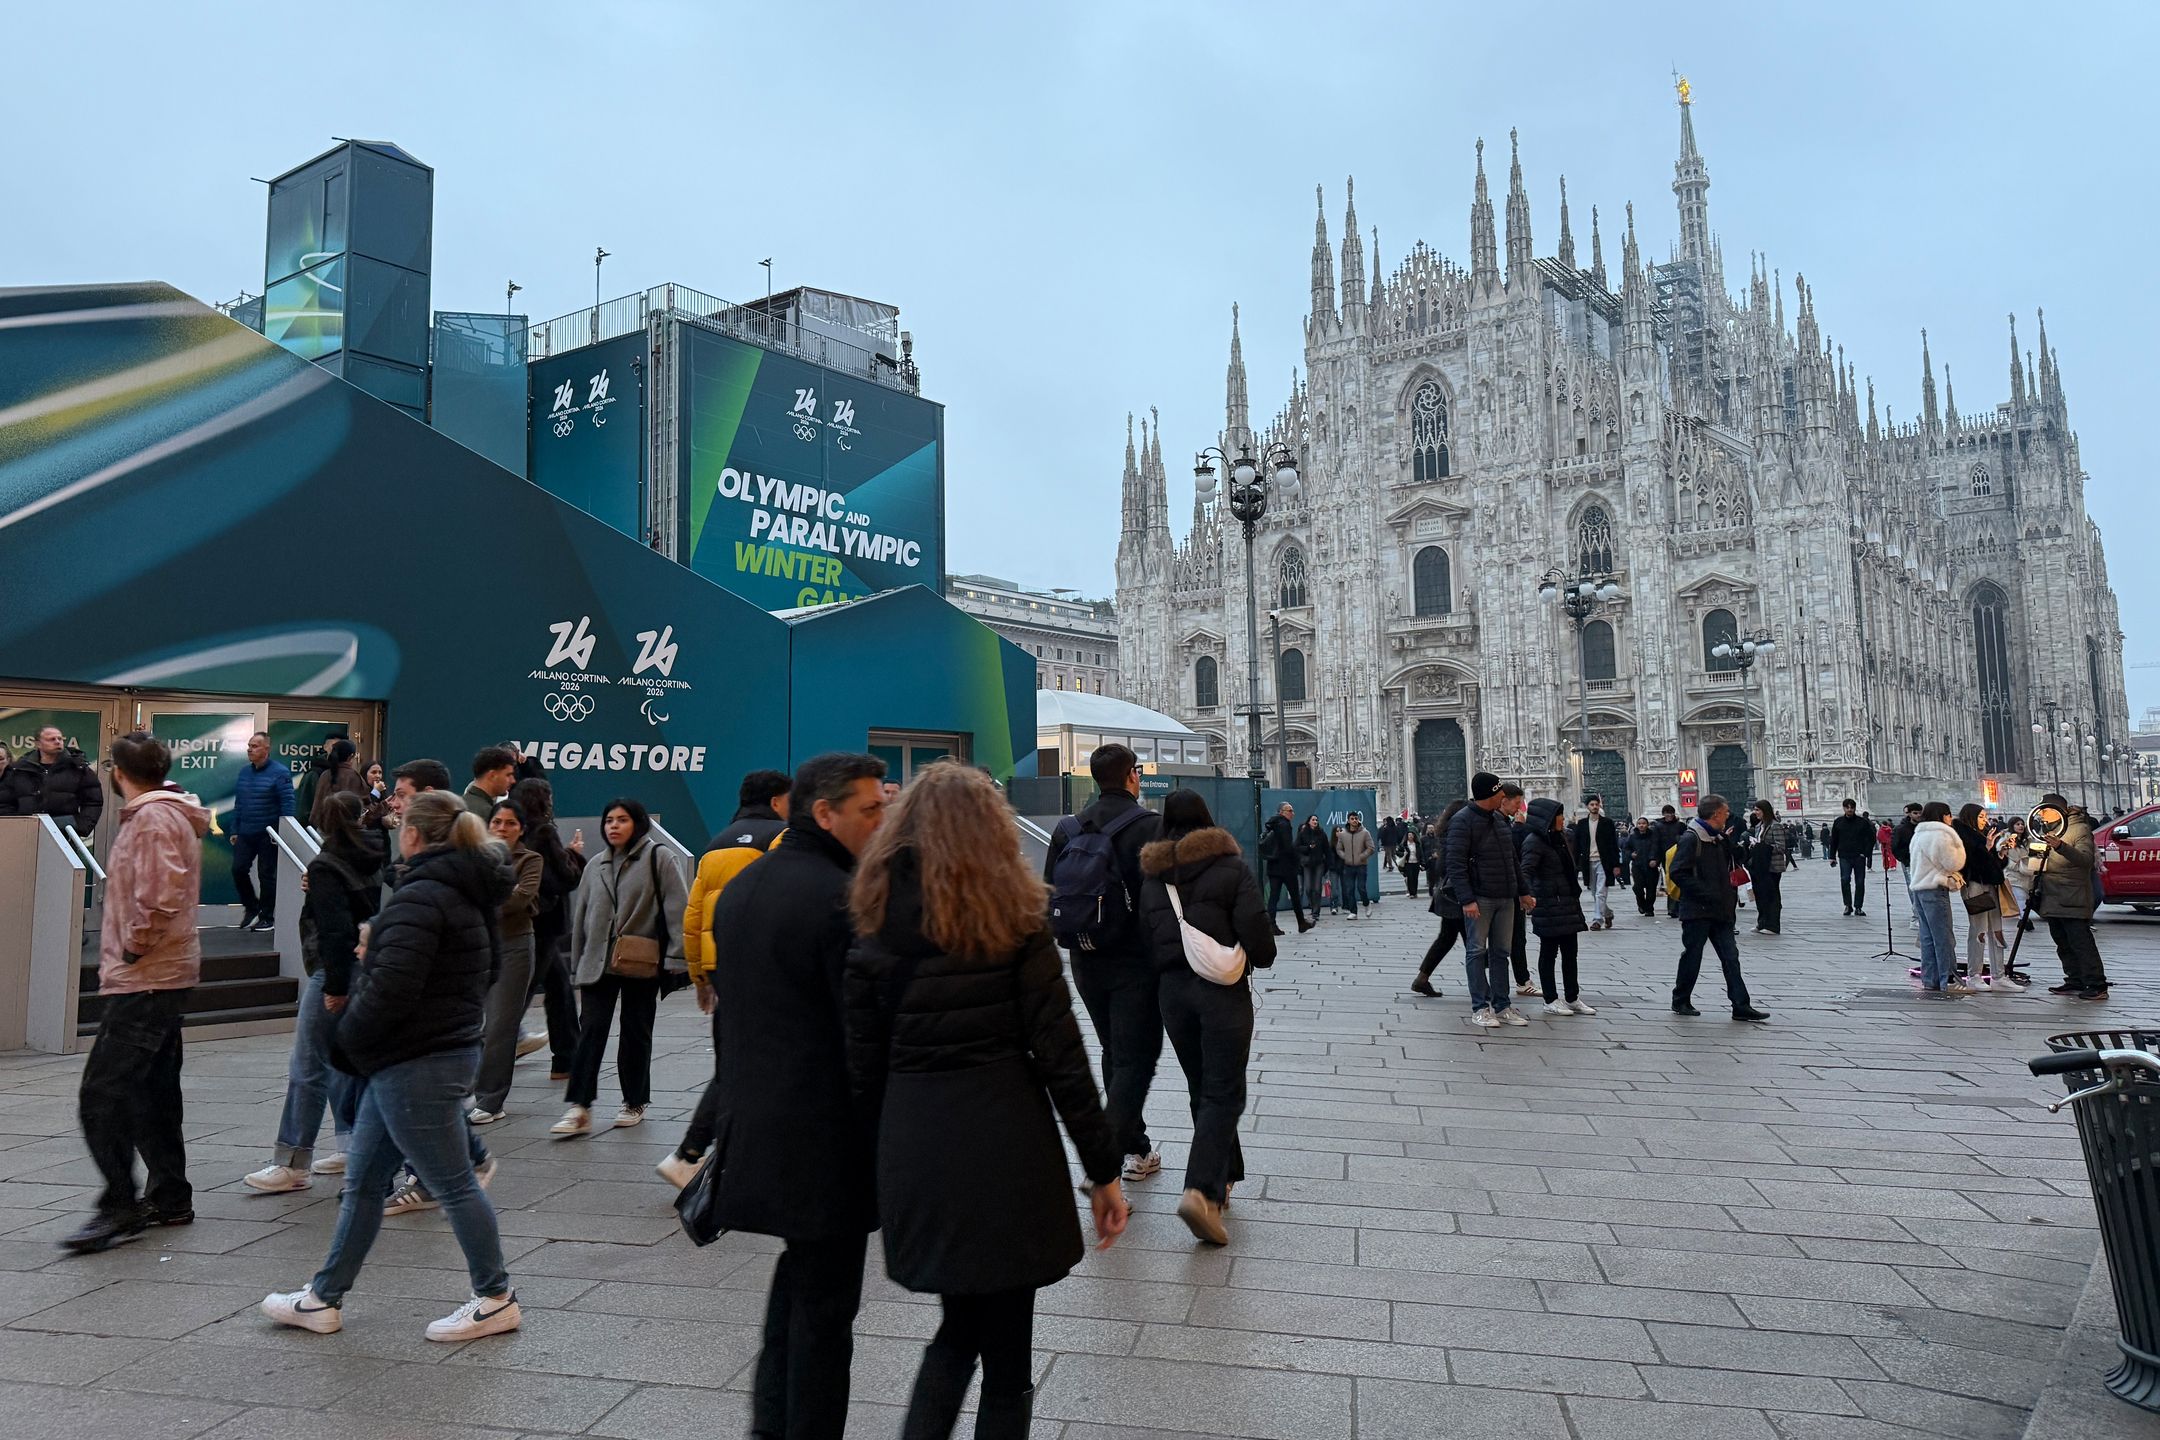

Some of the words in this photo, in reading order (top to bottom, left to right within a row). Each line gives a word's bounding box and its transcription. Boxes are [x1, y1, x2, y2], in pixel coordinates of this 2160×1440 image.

[547, 411, 564, 420] MILANO
[786, 410, 804, 420] MILANO
[827, 422, 844, 431] MILANO
[718, 468, 846, 520] OLYMPIC
[845, 511, 870, 527] AND
[750, 509, 921, 567] PARALYMPIC
[735, 541, 843, 587] WINTER
[528, 670, 569, 681] MILANO
[571, 672, 611, 684] CORTINA
[617, 676, 654, 687] MILANO
[655, 679, 692, 690] CORTINA
[560, 681, 580, 691] 2026
[646, 687, 664, 697] 2026
[279, 744, 323, 757] USCIT
[181, 756, 217, 769] EXIT
[290, 760, 312, 773] EXI
[1680, 770, 1695, 783] M
[1150, 780, 1169, 788] Entrance
